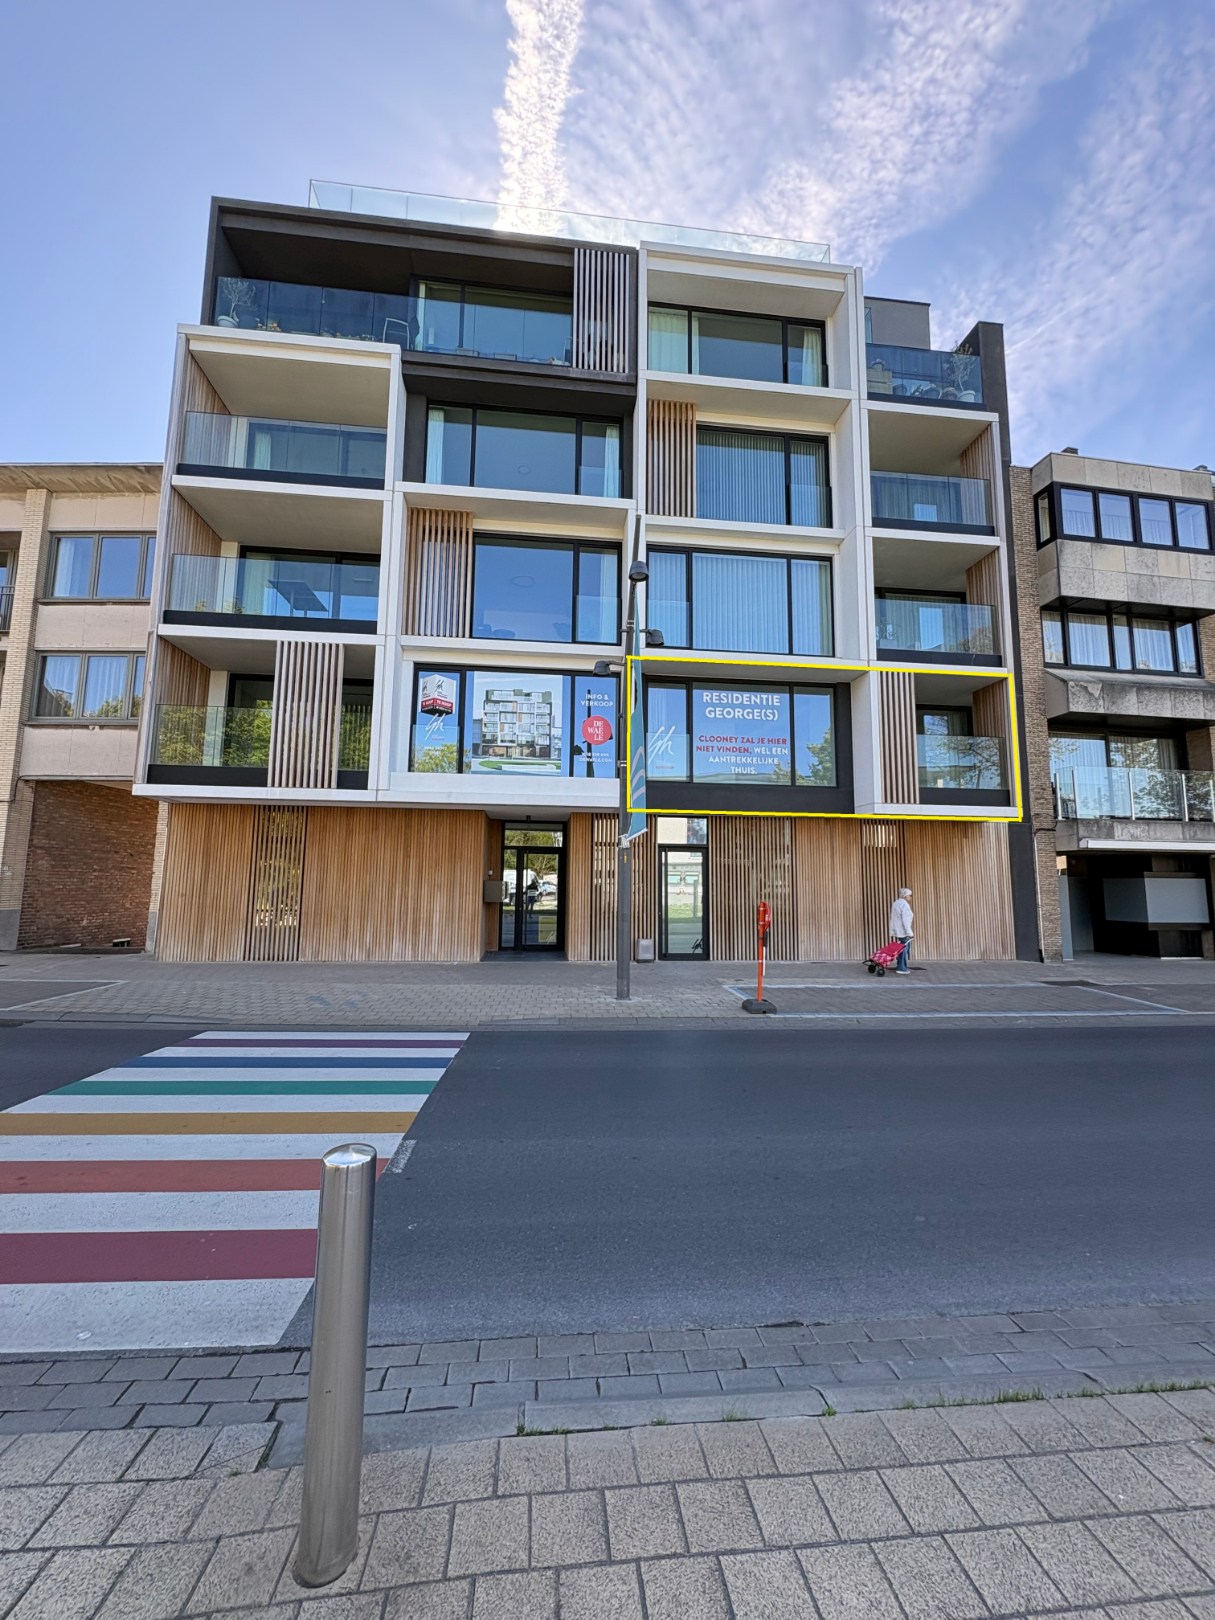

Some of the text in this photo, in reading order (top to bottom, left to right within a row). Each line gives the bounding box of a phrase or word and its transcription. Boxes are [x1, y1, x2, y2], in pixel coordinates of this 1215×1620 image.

[703, 692, 781, 706] RESIDENTIE
[705, 707, 779, 721] GEORGE(S)
[593, 720, 604, 728] DE
[698, 735, 788, 745] CLOONEY ZAL JE HIER
[716, 745, 752, 754] VINDEN,
[753, 747, 771, 755] WEL
[772, 747, 788, 756] EEN
[708, 756, 779, 764] AANTREKKELIJKE
[730, 766, 758, 774] THUIS.
